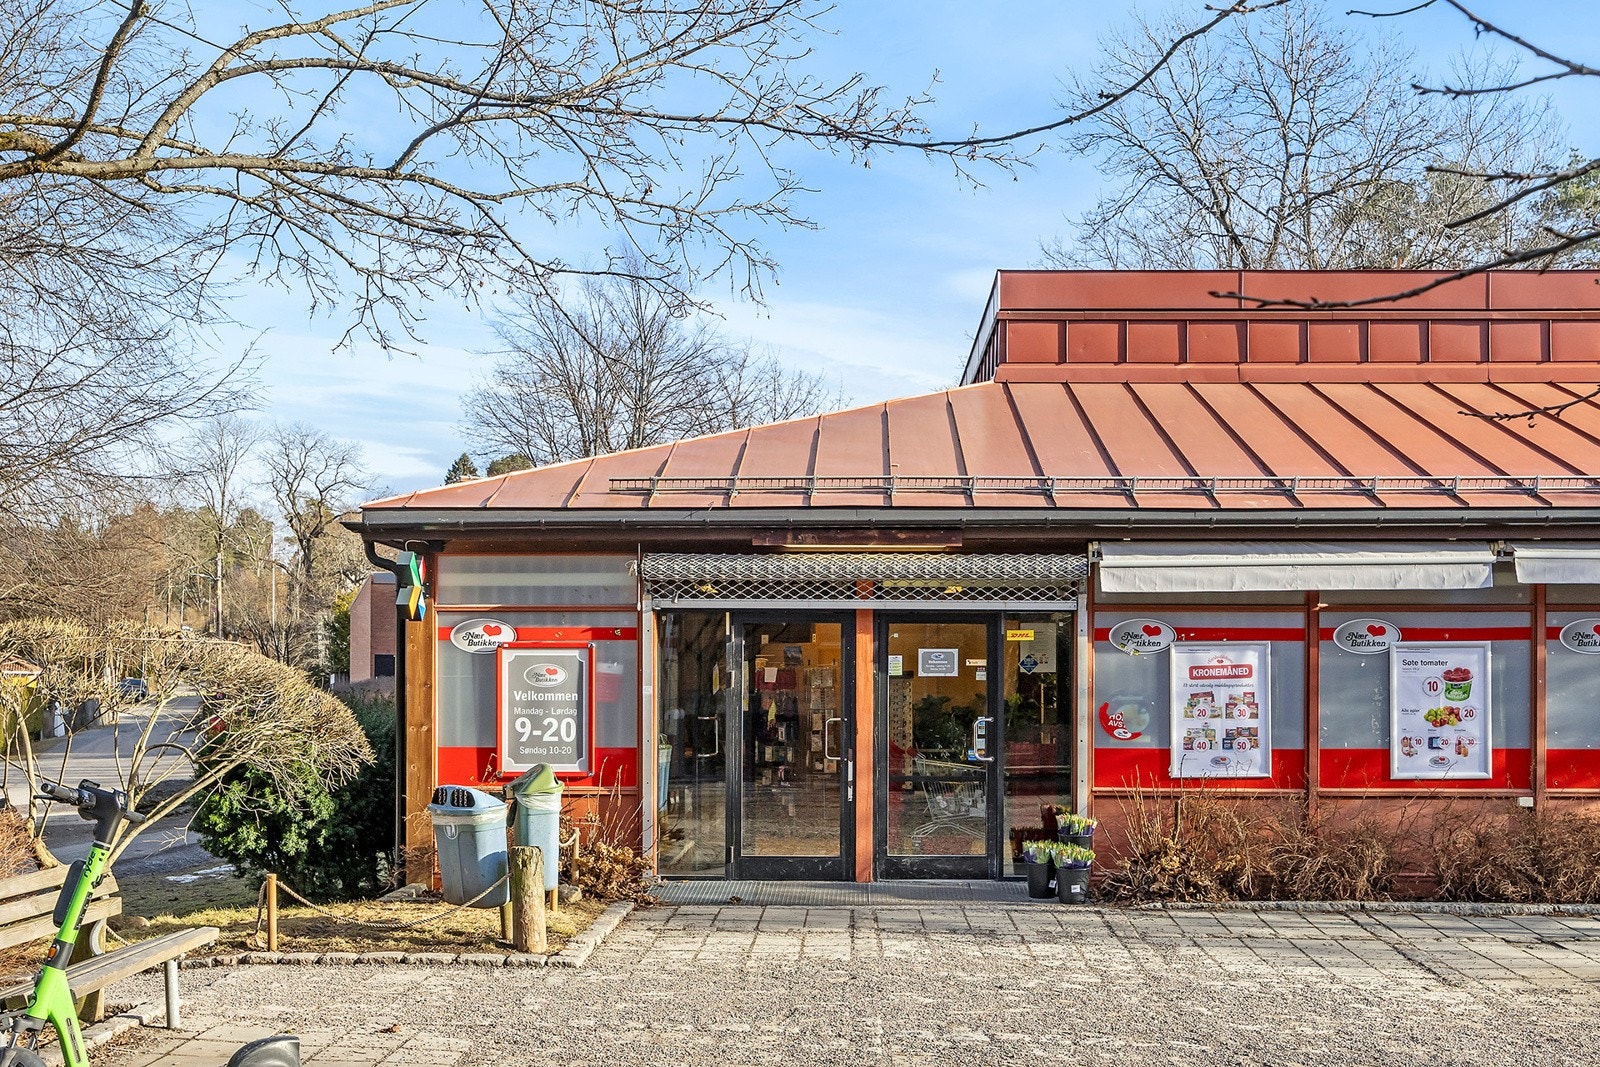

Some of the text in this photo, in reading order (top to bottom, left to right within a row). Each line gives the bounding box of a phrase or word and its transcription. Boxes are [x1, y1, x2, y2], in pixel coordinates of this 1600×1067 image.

[462, 631, 484, 641] Nær
[1121, 631, 1144, 641] Nær
[1345, 631, 1368, 641] Nær
[1572, 631, 1595, 641] Nær
[1351, 639, 1386, 647] Butikken
[1577, 639, 1600, 647] Butik
[1402, 659, 1449, 667] Søte tomater
[1192, 666, 1249, 677] KRONEMÅNED
[1427, 681, 1438, 692] 10
[513, 690, 578, 701] Velkommen
[513, 707, 544, 716] Mandag
[551, 707, 578, 717] Lørdag
[1197, 708, 1207, 718] 20
[1237, 708, 1247, 718] 30
[1464, 709, 1474, 718] 20
[514, 716, 577, 743] 9-20
[1197, 741, 1207, 751] 40
[1237, 741, 1247, 751] 50
[1415, 738, 1422, 746] 10
[1441, 738, 1449, 746] 20
[1467, 738, 1475, 746] 30
[519, 746, 572, 755] Søndag 10-20
[84, 851, 96, 878] ryde
